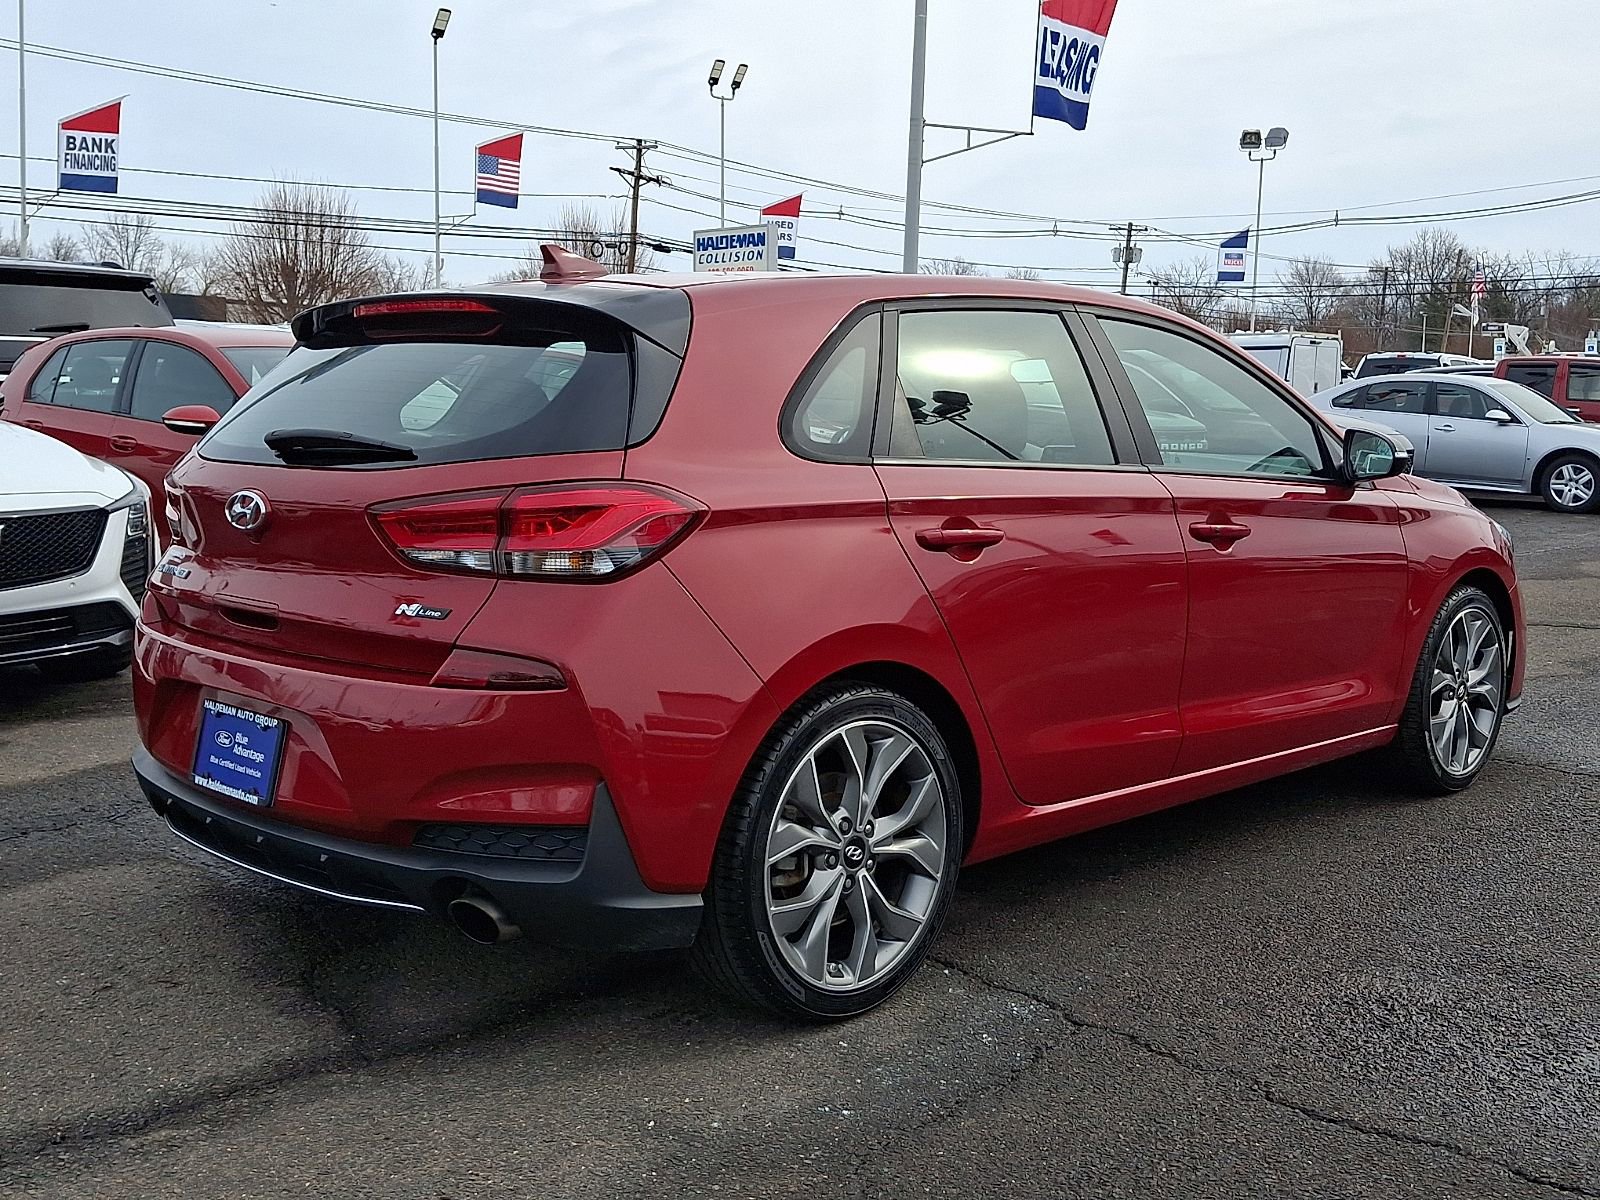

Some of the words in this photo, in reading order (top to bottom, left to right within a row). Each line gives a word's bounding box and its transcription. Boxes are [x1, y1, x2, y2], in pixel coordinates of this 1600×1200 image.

[1040, 26, 1100, 94] LEASING
[66, 135, 116, 154] BANK
[64, 152, 116, 172] FINANCING
[697, 232, 766, 252] HALDEMAN
[698, 250, 764, 264] COLLISION
[418, 609, 441, 617] Line
[204, 700, 237, 716] HALDEMAN
[237, 710, 254, 721] AUTO
[255, 714, 278, 728] GROUP
[217, 732, 231, 745] Ford
[235, 732, 248, 745] Blue
[233, 744, 265, 762] Advantage
[218, 758, 235, 769] Certified
[234, 763, 246, 774] Used
[245, 768, 261, 778] Vehicle
